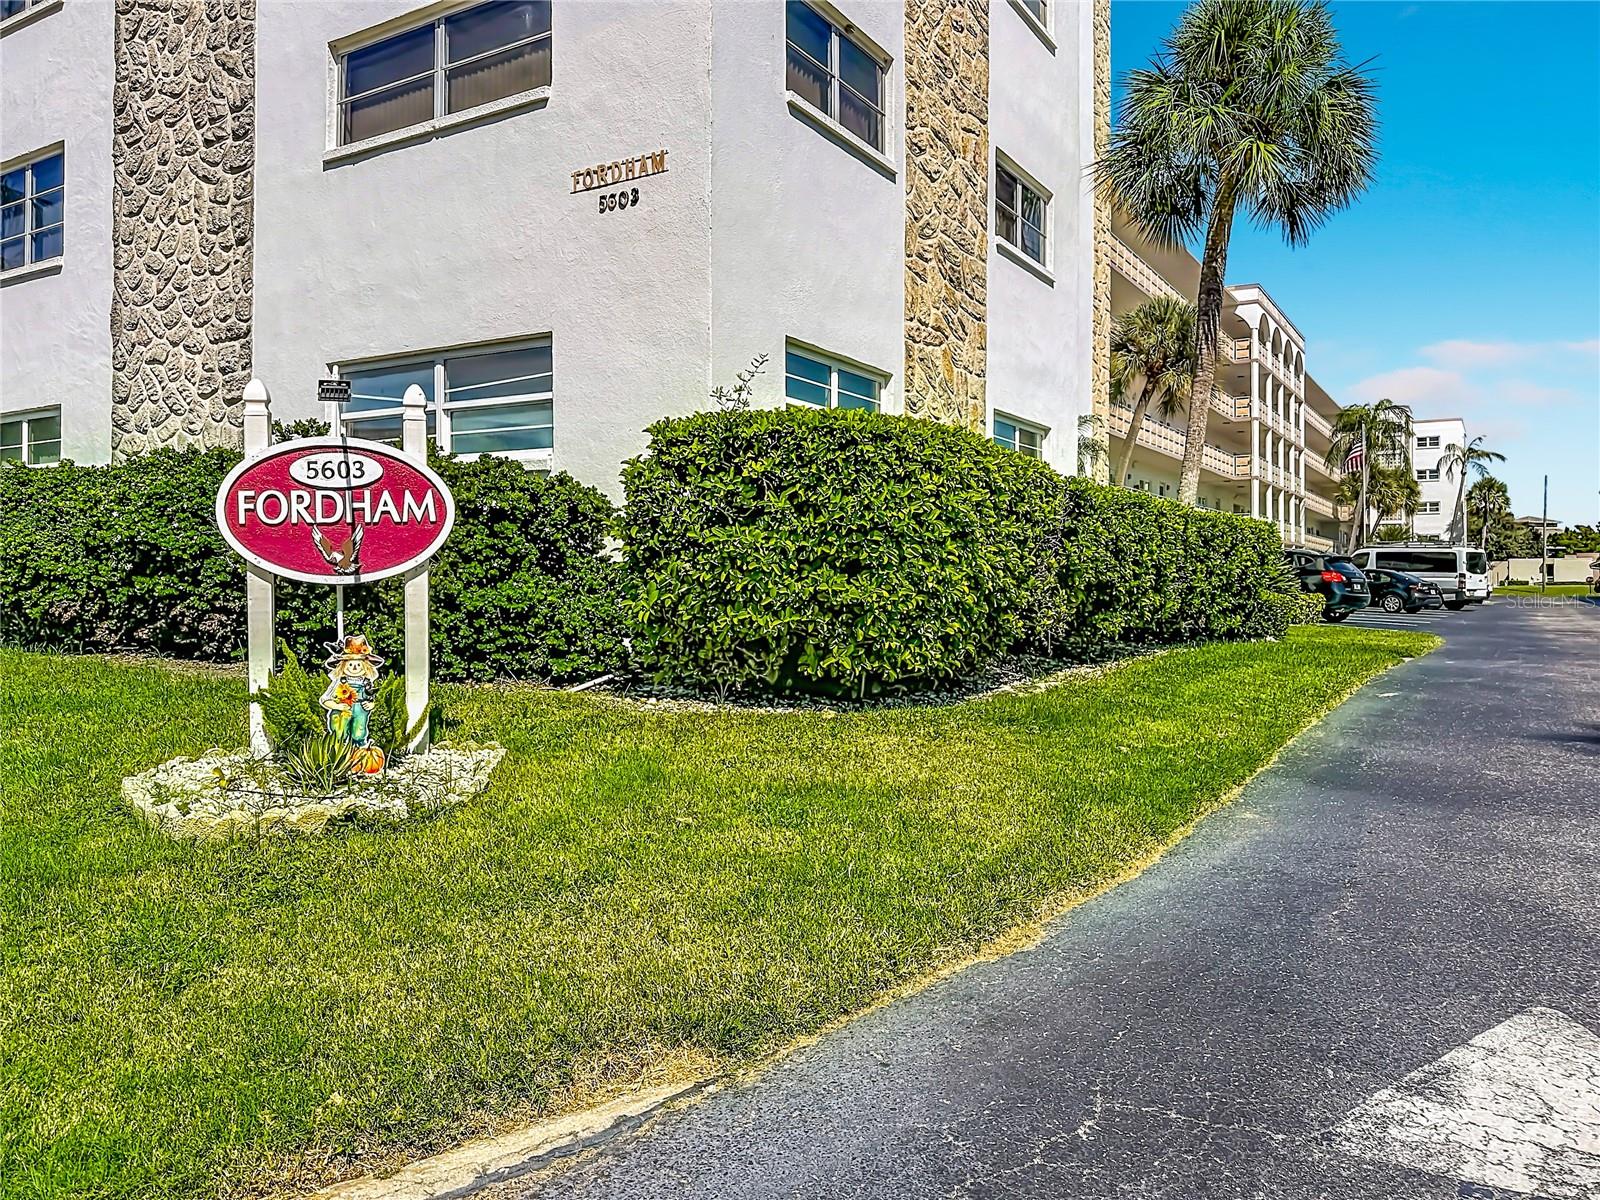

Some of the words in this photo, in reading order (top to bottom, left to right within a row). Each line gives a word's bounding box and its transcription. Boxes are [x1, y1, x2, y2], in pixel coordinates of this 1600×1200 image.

[571, 149, 666, 192] FORDHAM
[599, 187, 640, 214] 5603
[306, 460, 365, 480] 5603
[237, 489, 437, 525] FORDHAM
